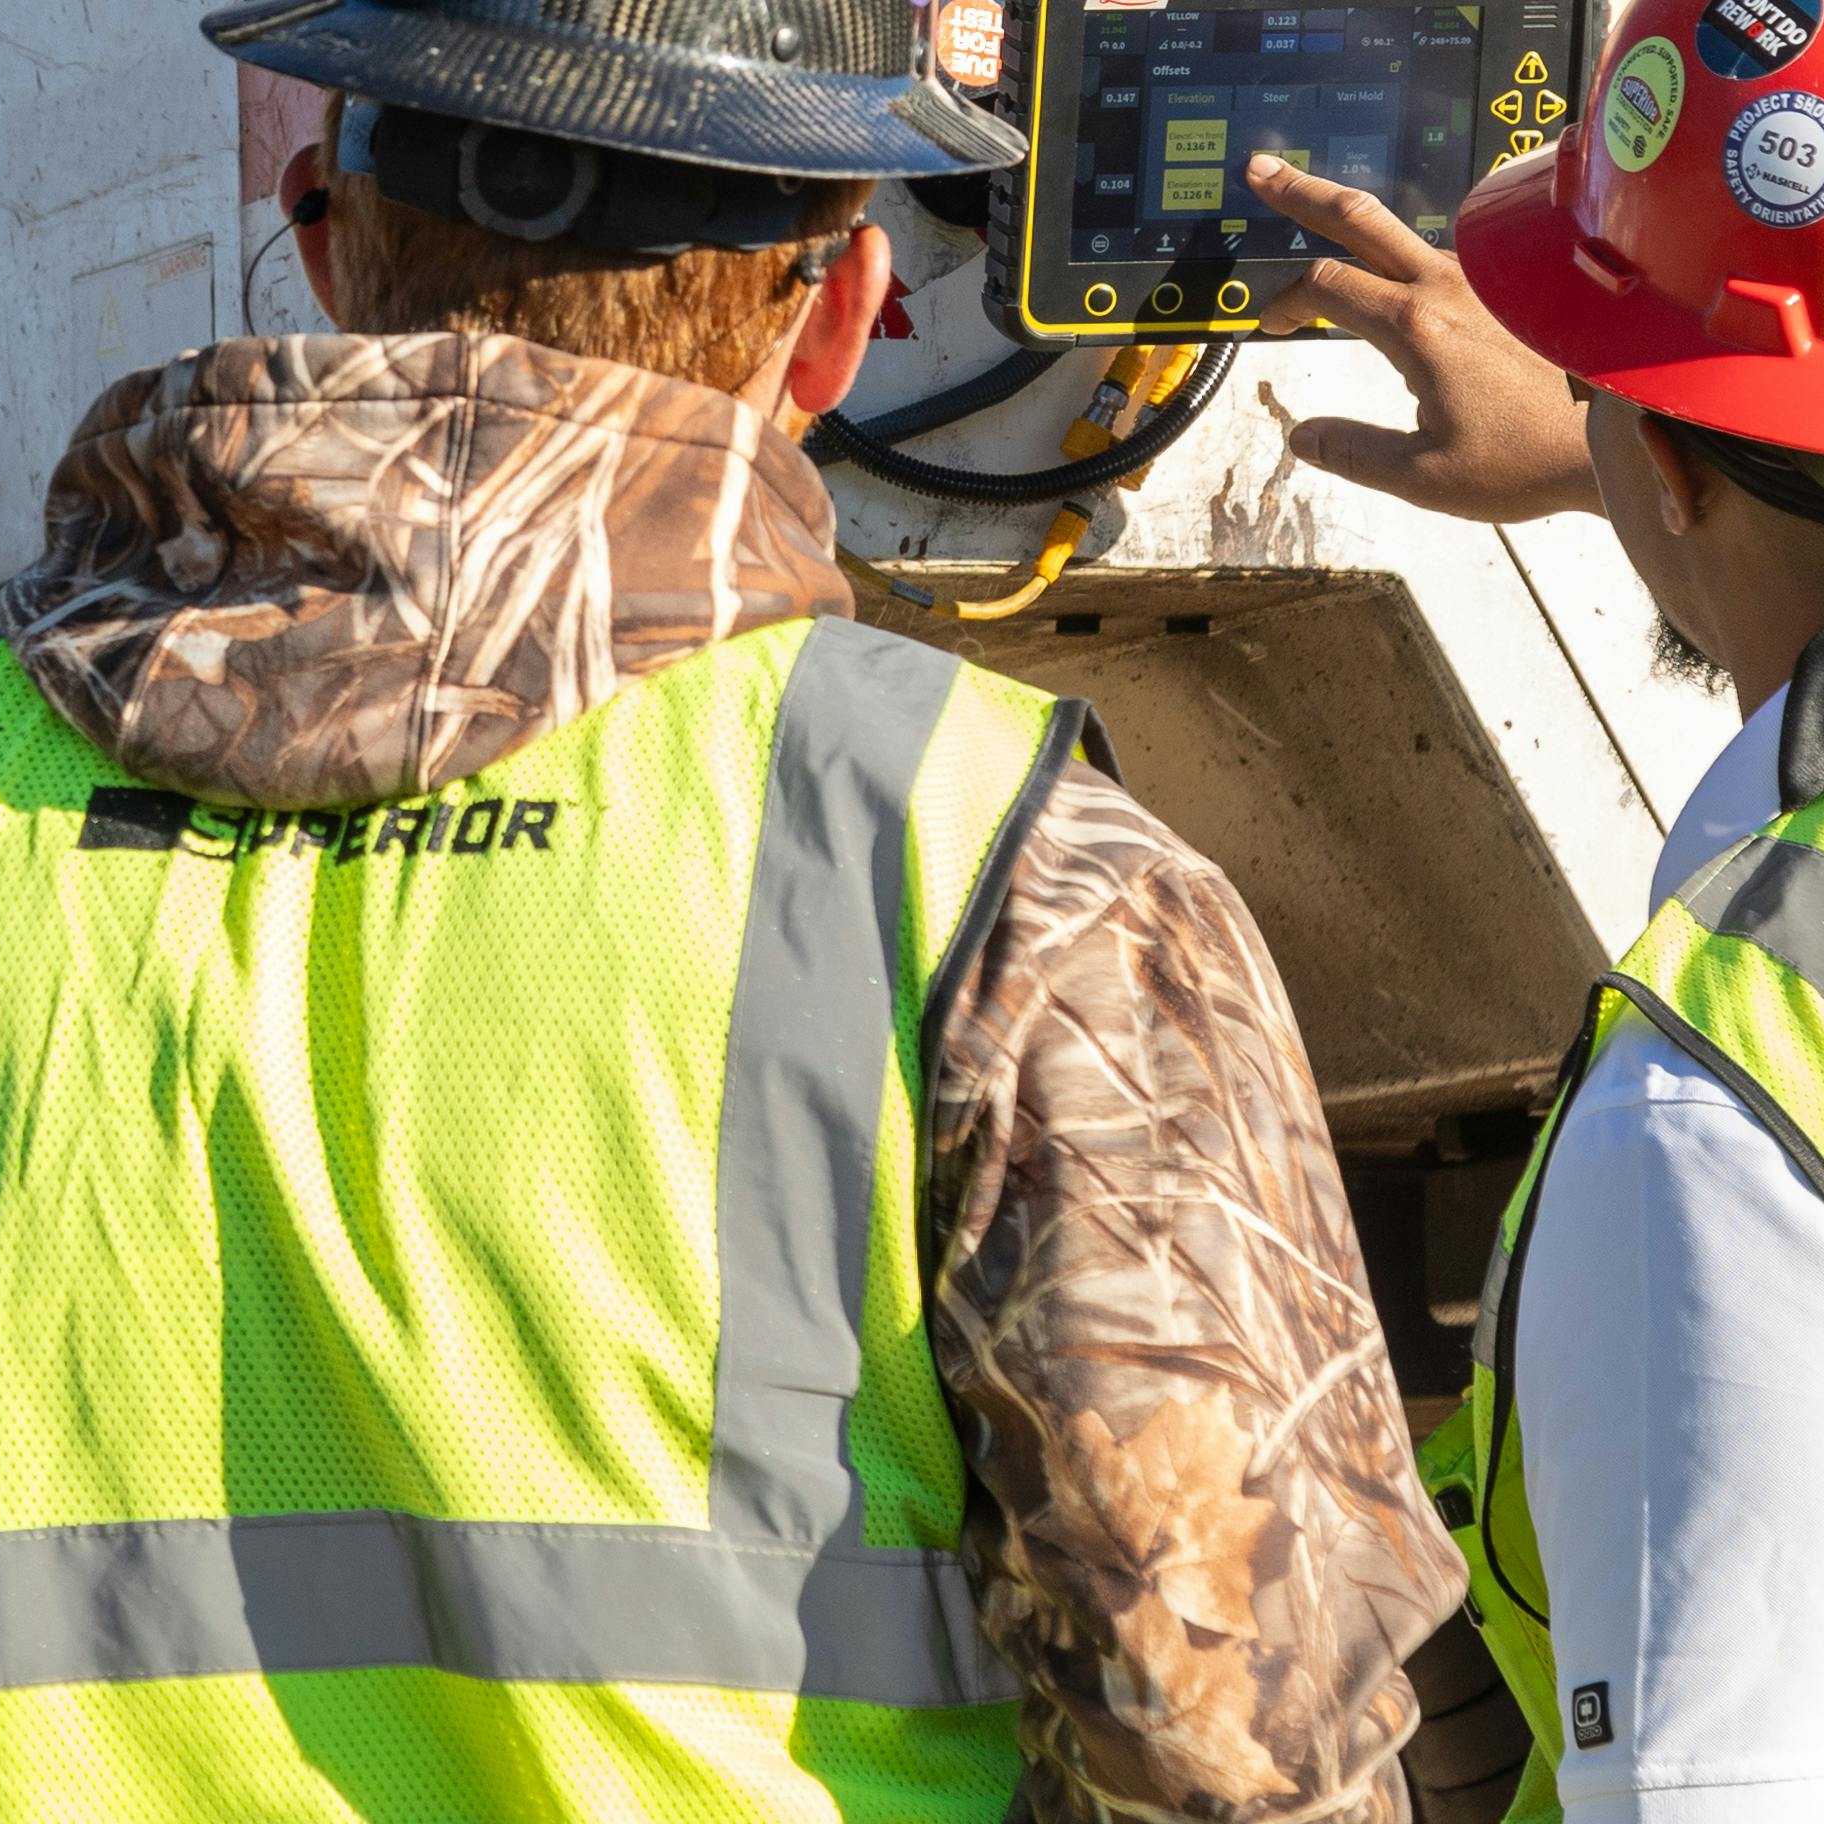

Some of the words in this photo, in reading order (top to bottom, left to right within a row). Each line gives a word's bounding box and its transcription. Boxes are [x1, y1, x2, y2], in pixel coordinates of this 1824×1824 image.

[950, 5, 1005, 34] TEST
[1166, 12, 1200, 21] YELLOW
[1267, 16, 1297, 26] 0.123
[1775, 17, 1808, 45] DO
[952, 26, 1002, 56] FOR
[1112, 41, 1126, 50] 0.0
[1265, 39, 1295, 49] 0.037
[951, 52, 999, 79] DUE
[1152, 65, 1191, 76] Offsets
[1106, 93, 1136, 103] 0.147
[1168, 92, 1215, 104] Elevation
[1263, 92, 1290, 103] Steer
[1337, 90, 1357, 101] Vari
[1358, 88, 1384, 101] Mold
[1729, 93, 1791, 142] PROJECT
[1176, 142, 1205, 151] 0.136
[1207, 140, 1217, 151] ft
[1758, 129, 1818, 168] 503
[1342, 164, 1360, 174] 2.0
[1360, 164, 1371, 174] %
[1726, 148, 1753, 204] SAFETY
[1100, 181, 1130, 190] 0.104
[1762, 170, 1811, 195] HASKELL
[1173, 191, 1202, 200] 0.126
[1204, 190, 1213, 199] ft
[177, 800, 558, 864] SUPERIOR
